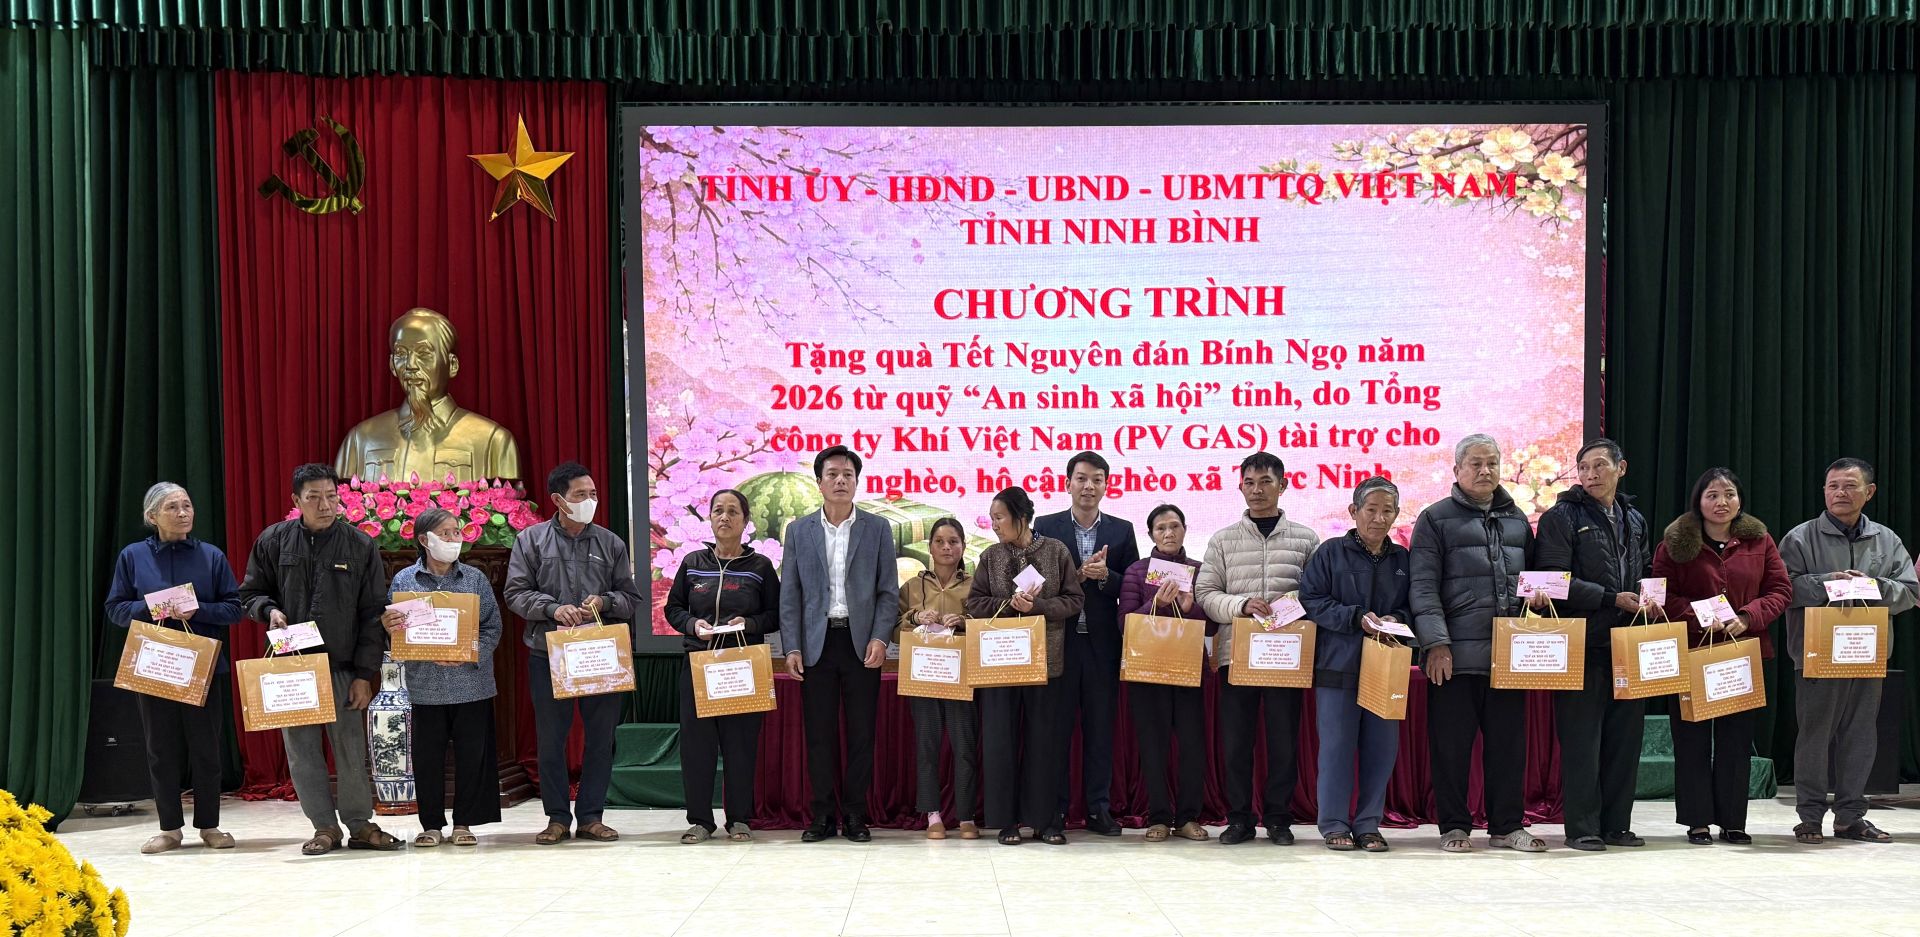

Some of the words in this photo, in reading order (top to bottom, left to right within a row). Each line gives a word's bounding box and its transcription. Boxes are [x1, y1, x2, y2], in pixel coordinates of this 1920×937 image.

[697, 167, 793, 203] TỈNH
[804, 167, 858, 203] ỦY
[864, 188, 878, 196] -
[888, 175, 995, 203] HĐND
[1027, 175, 1130, 202] UBND
[1163, 172, 1326, 205] UBMTTQ
[1334, 168, 1423, 206] VIỆT
[1432, 171, 1518, 200] NAM
[959, 211, 1050, 245] TỈNH
[1063, 218, 1156, 245] NINH
[1168, 209, 1260, 244] BÌNH
[933, 283, 1132, 321] CHƯƠNG
[1144, 277, 1286, 319] TRÌNH
[785, 341, 866, 375] Tặng
[875, 342, 933, 376] quà
[943, 335, 995, 368] Tết
[1005, 341, 1122, 374] Nguyên
[1132, 340, 1189, 366] đán
[1201, 339, 1273, 365] Bính
[1285, 338, 1348, 371] Ngọ
[1358, 338, 1426, 363] năm
[770, 384, 843, 410] 2026
[852, 384, 888, 411] từ
[895, 384, 953, 418] quỹ
[963, 385, 1027, 410] “An
[1037, 384, 1099, 409] sinh
[1111, 383, 1145, 408] xã
[1156, 382, 1221, 415] hội”
[1231, 381, 1303, 411] tỉnh,
[1312, 380, 1350, 407] do
[1360, 372, 1441, 411] Tổng
[852, 428, 882, 459] ty
[892, 426, 949, 452] Khí
[957, 425, 1020, 459] Việt
[1030, 426, 1104, 452] Nam
[1113, 425, 1173, 456] (PV
[1182, 423, 1268, 453] GAS)
[1278, 422, 1318, 448] tài
[1329, 424, 1379, 454] trợ
[1385, 420, 1441, 447] cho
[866, 467, 966, 501] nghèo,
[1105, 465, 1177, 499] ghèo
[1187, 465, 1222, 491] xã
